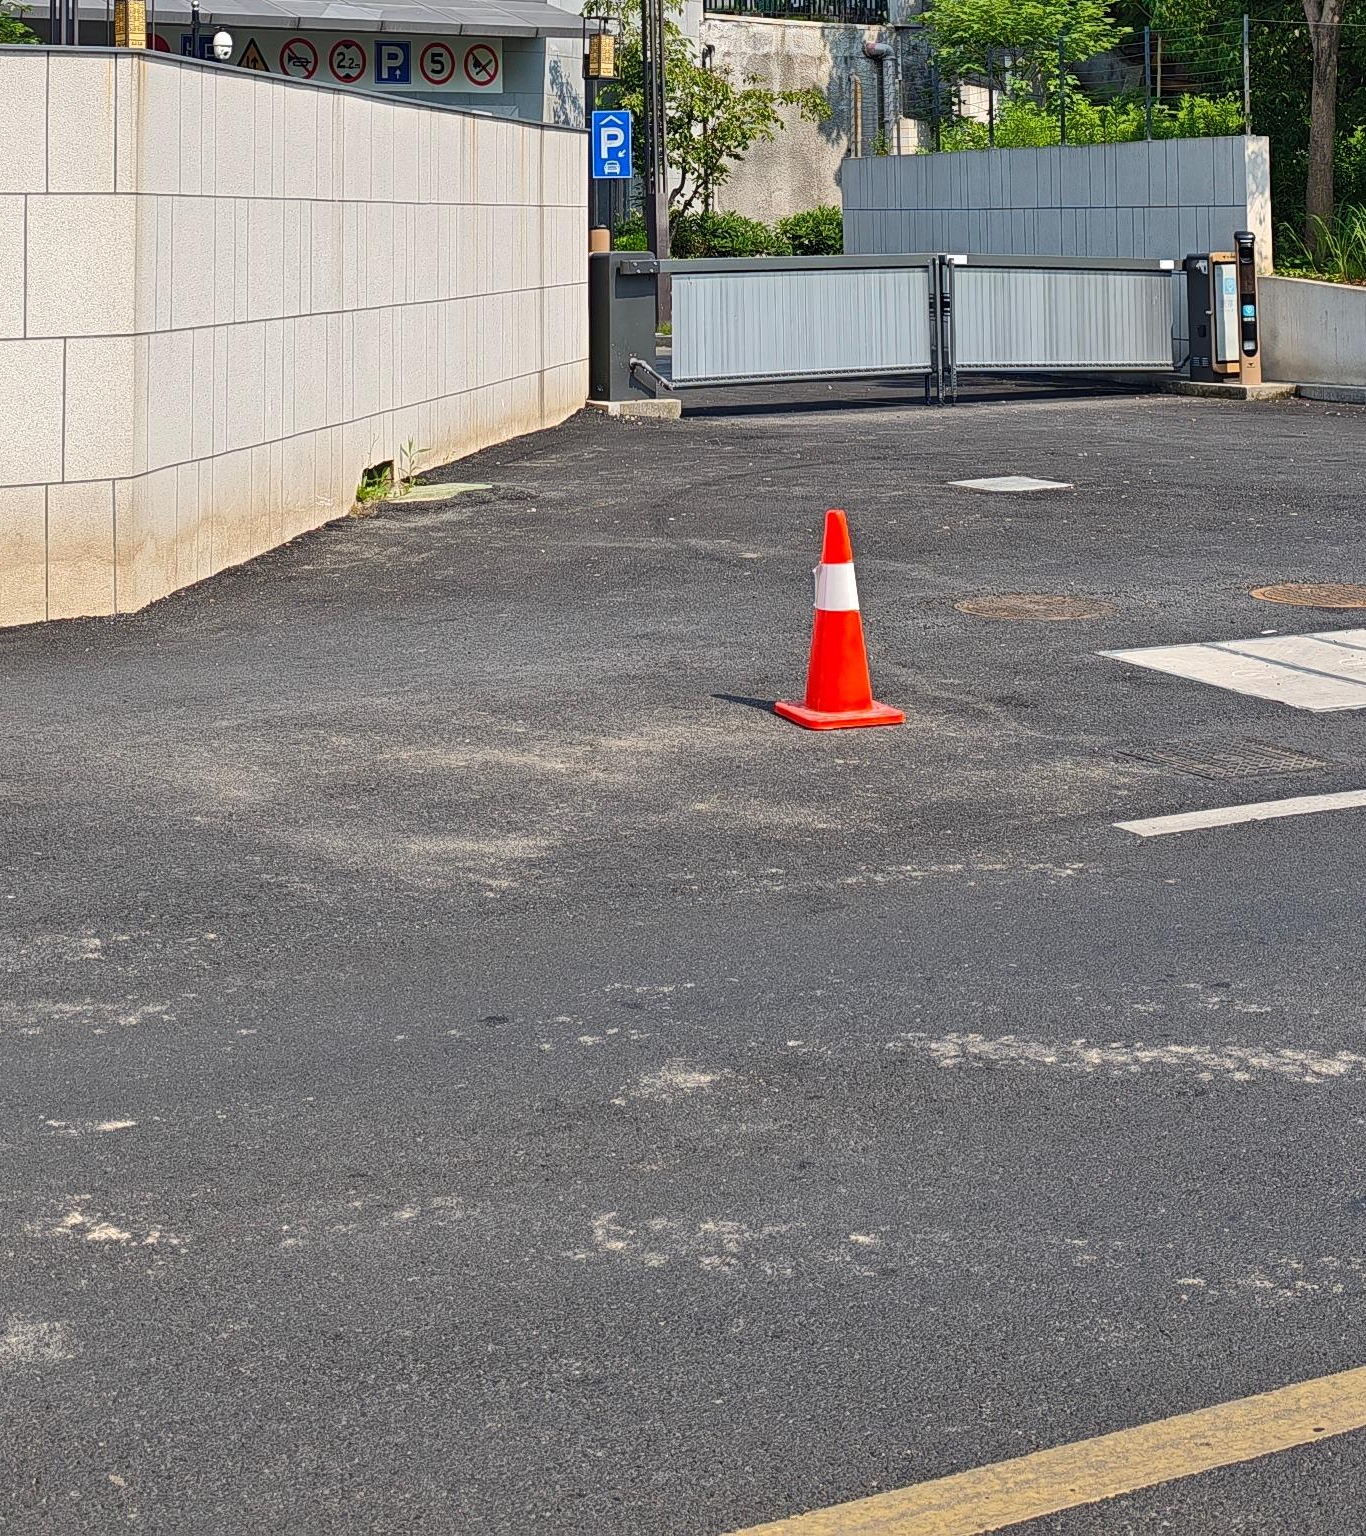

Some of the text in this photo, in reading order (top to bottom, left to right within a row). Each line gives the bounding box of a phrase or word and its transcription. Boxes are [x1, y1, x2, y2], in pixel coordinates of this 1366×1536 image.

[381, 46, 404, 79] P
[430, 52, 445, 75] 5
[601, 127, 624, 159] P
